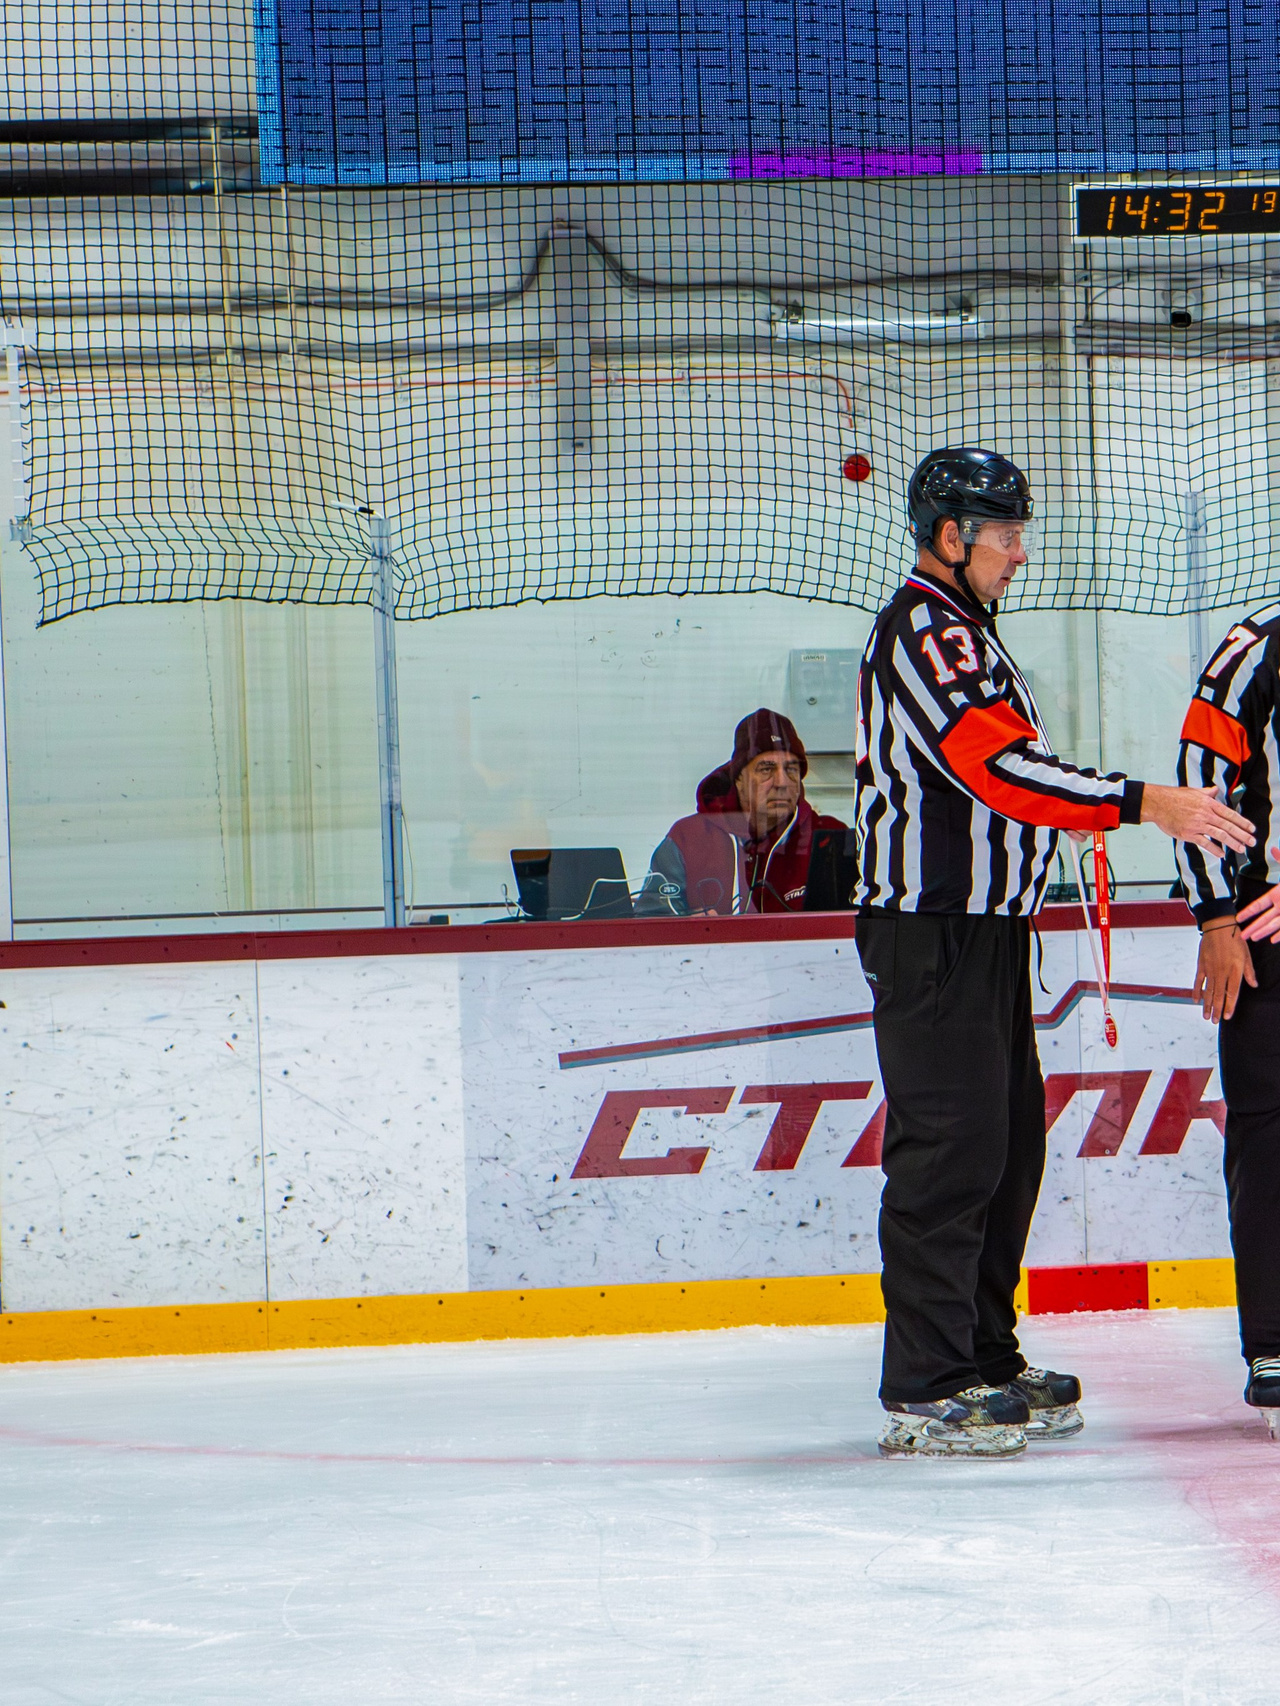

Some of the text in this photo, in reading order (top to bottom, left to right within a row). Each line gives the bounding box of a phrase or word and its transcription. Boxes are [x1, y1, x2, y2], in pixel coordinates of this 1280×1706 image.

[1106, 191, 1277, 231] 14:32 19
[920, 625, 979, 687] 13
